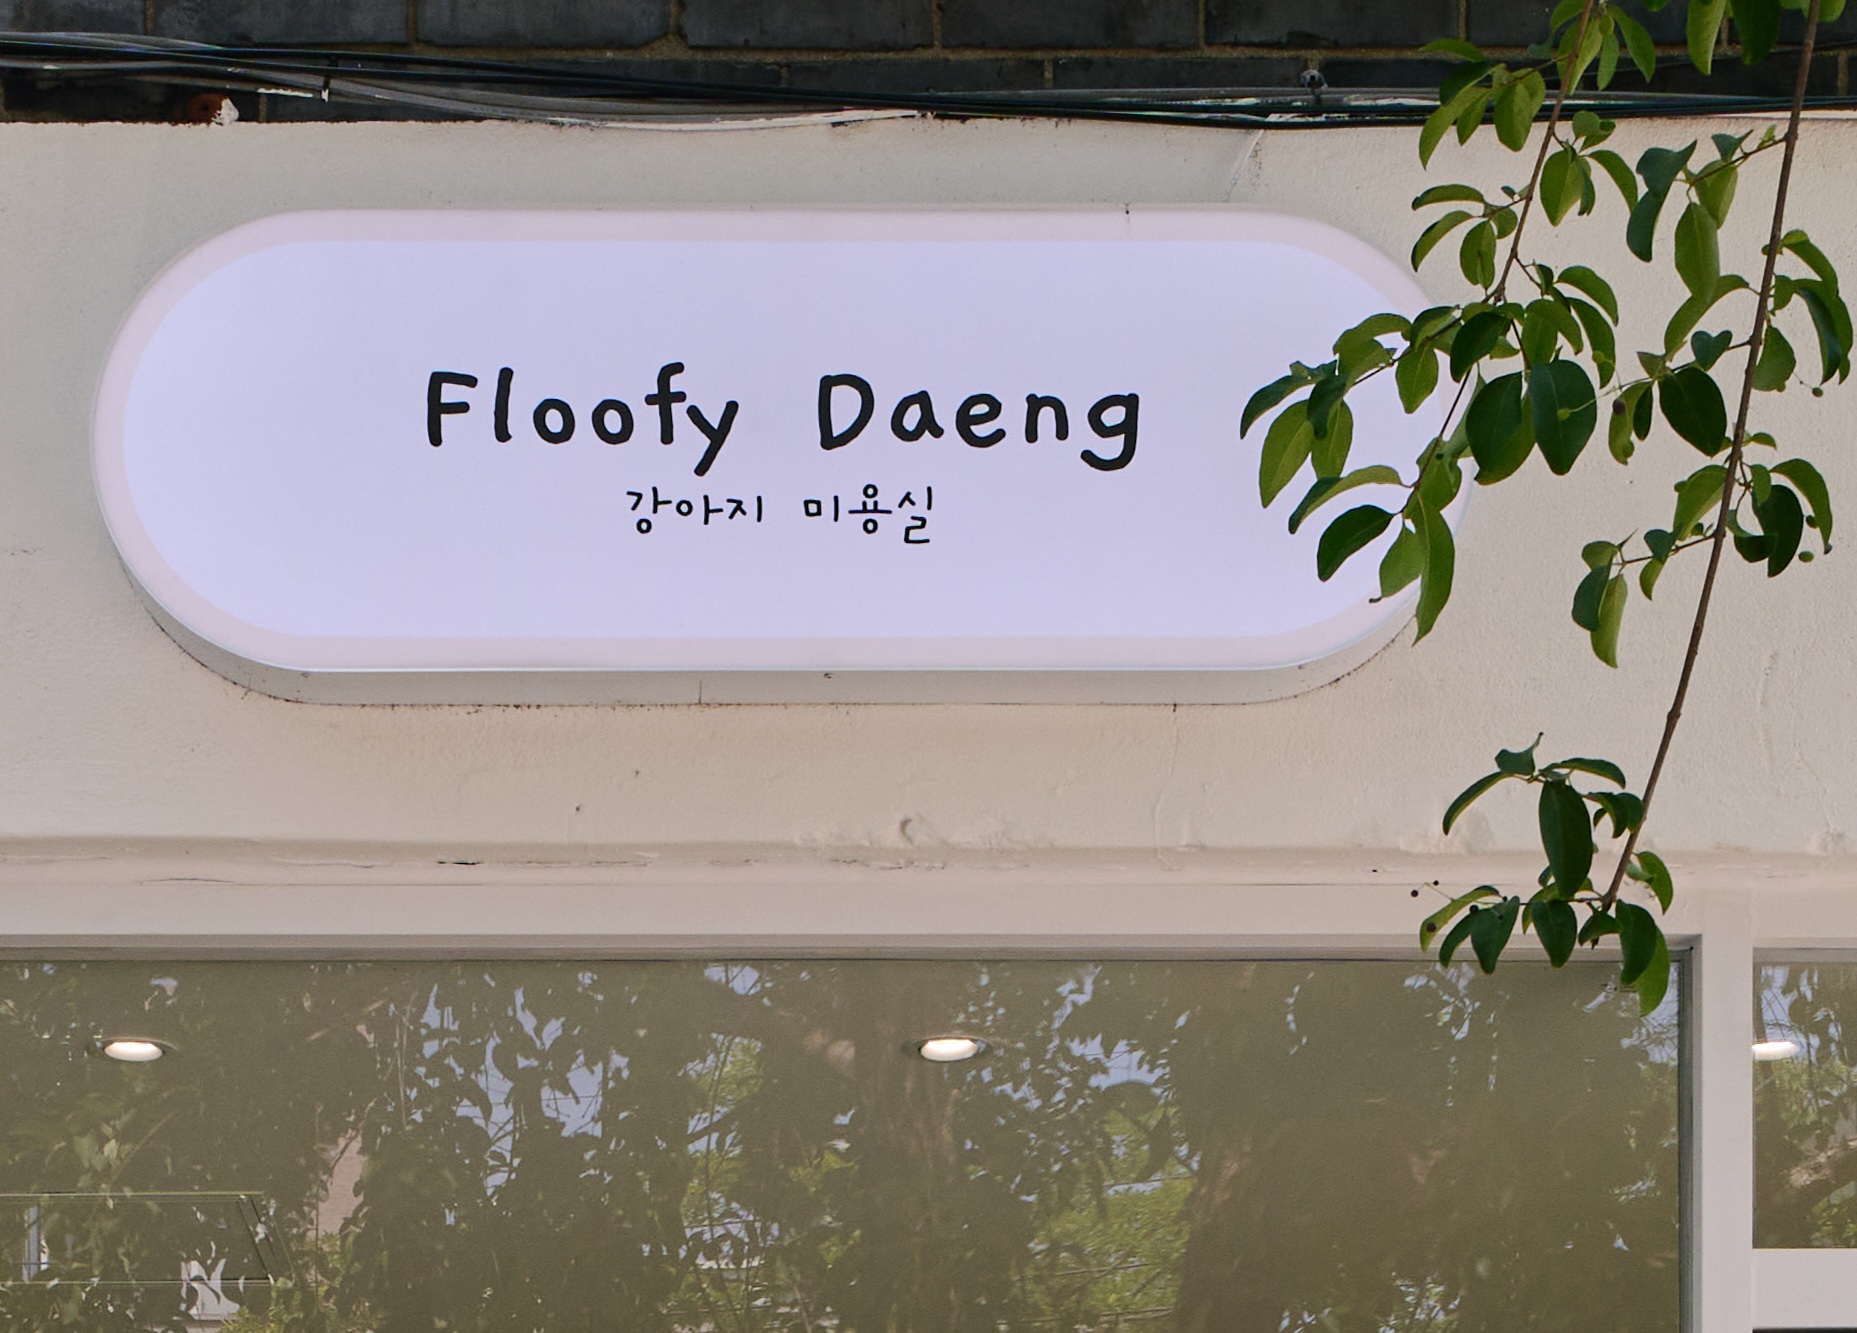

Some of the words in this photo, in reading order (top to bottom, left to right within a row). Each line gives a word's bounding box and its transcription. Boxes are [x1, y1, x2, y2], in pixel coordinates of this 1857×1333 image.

[426, 362, 739, 476] Floofy
[817, 373, 1140, 471] Daeng
[625, 486, 764, 535] 강아지
[803, 484, 934, 545] 미용실
